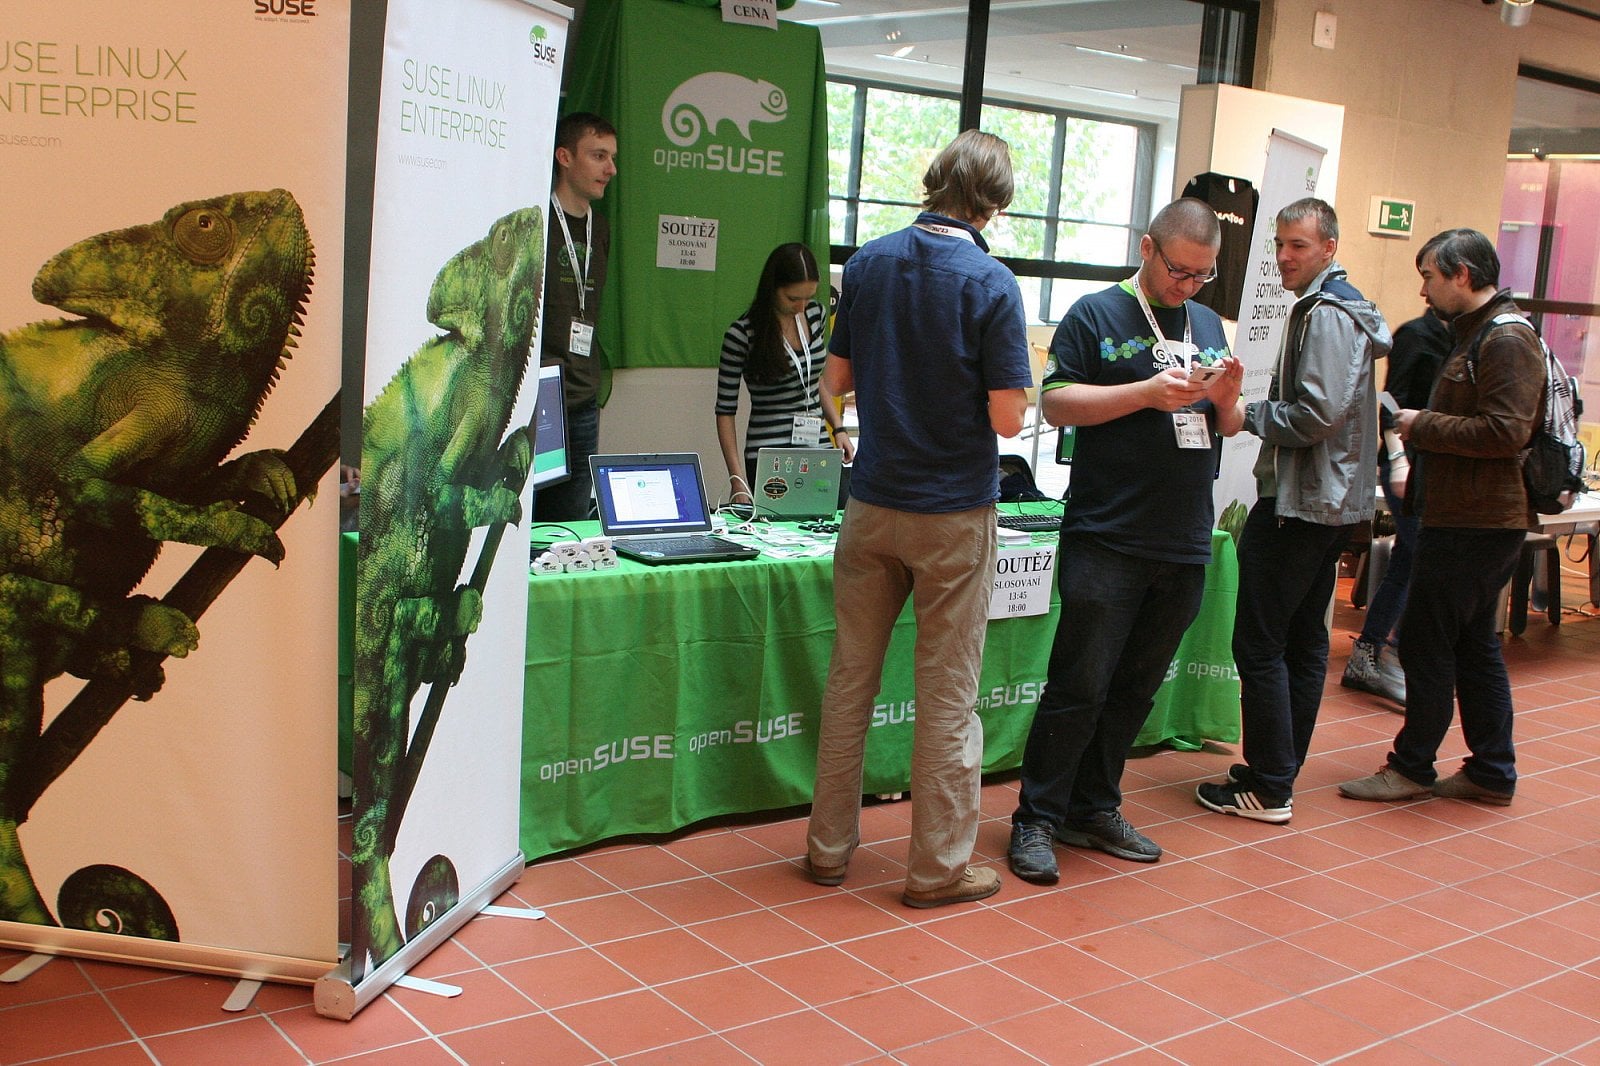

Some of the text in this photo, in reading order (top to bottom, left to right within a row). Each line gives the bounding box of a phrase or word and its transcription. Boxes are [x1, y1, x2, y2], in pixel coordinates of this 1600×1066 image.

[253, 0, 316, 16] SUSE
[733, 5, 769, 20] CENA
[75, 44, 188, 82] LINUX
[534, 43, 556, 63] SUSE
[402, 58, 506, 112] SUSE LINUX
[400, 100, 508, 149] ENTERPRISE
[653, 144, 784, 177] openSUSE
[661, 221, 716, 239] SOUTĚŽ
[1249, 326, 1269, 341] CENTER
[997, 551, 1052, 574] OUTĚŽ
[1009, 591, 1028, 601] 13:45
[1008, 603, 1026, 613] 18:00
[872, 699, 916, 728] SUS
[689, 712, 804, 755] openSUSE
[540, 735, 675, 783] openSUSE
